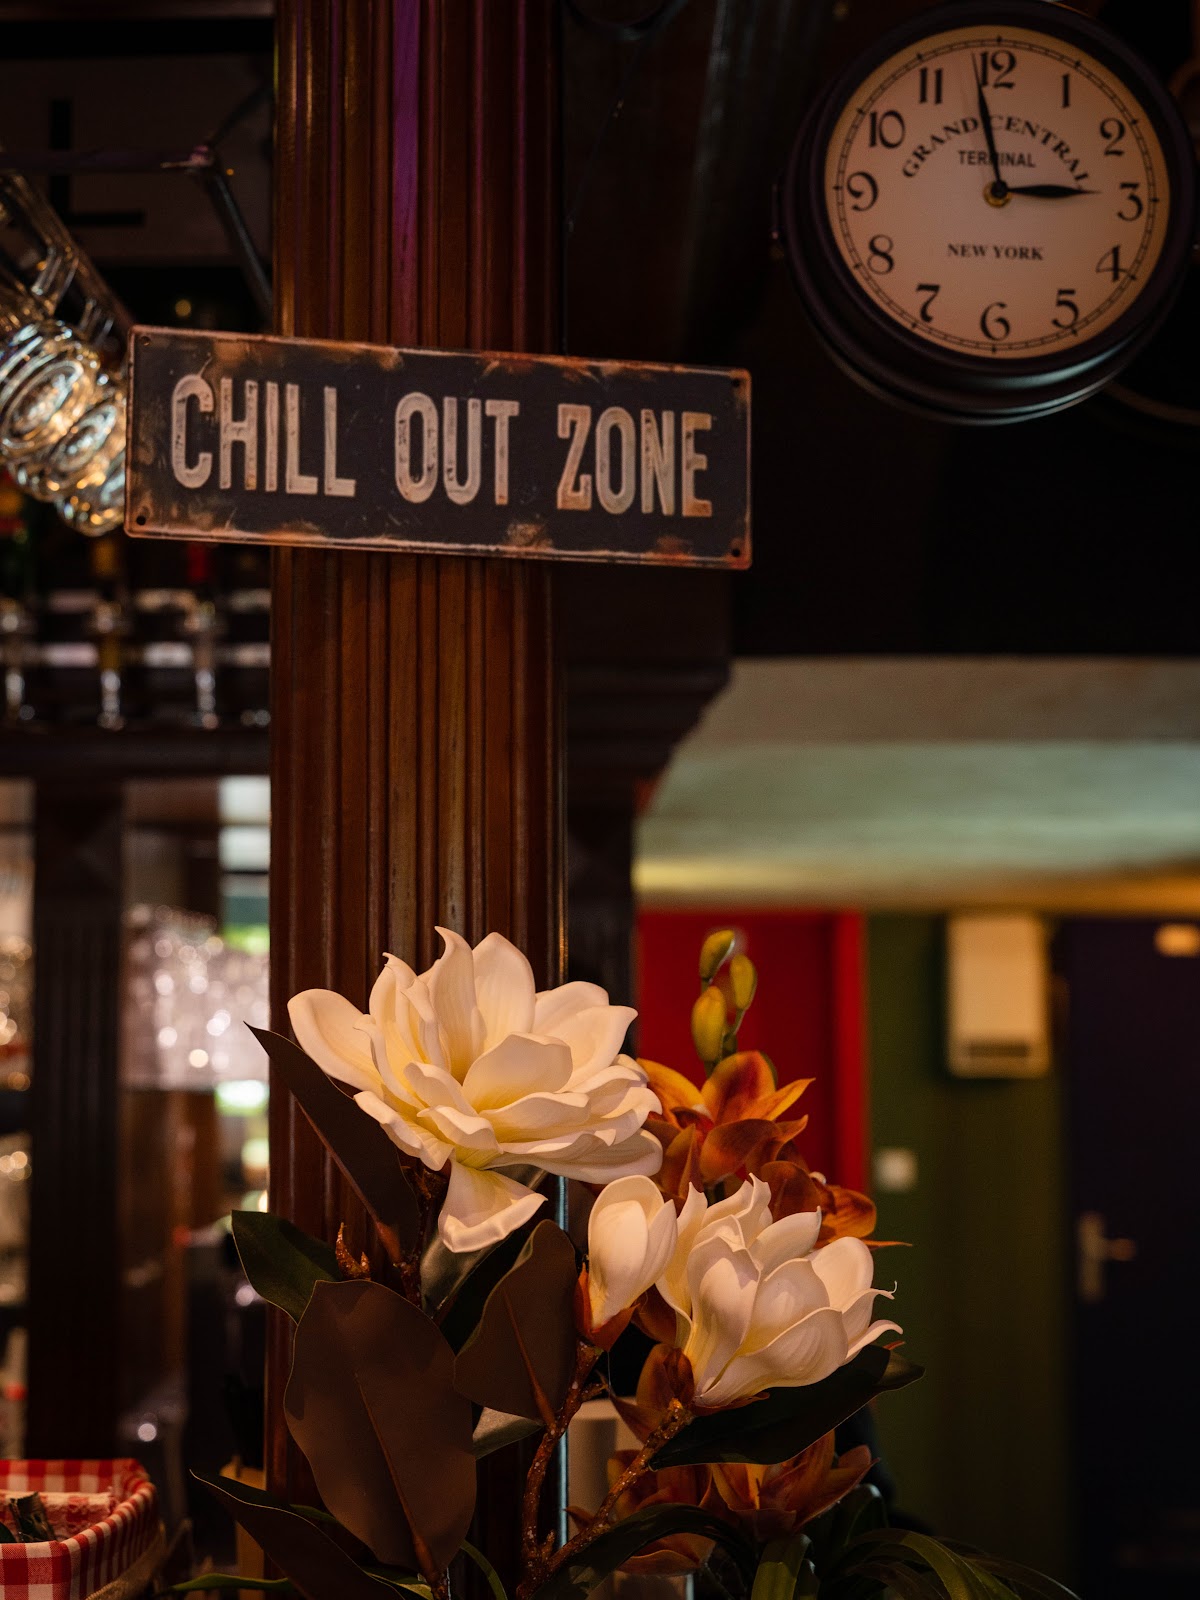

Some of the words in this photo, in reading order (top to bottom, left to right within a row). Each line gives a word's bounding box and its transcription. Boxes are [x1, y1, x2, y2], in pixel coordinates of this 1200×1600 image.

[919, 67, 943, 104] 11
[978, 50, 1016, 88] 12
[1061, 73, 1071, 108] 1
[868, 110, 905, 149] 10
[903, 116, 978, 178] GRAND
[1100, 118, 1125, 156] 2
[846, 171, 878, 212] 9
[1117, 182, 1143, 221] 3
[867, 235, 894, 275] 8
[947, 243, 986, 258] NEW
[993, 245, 1043, 261] YORK
[1095, 245, 1129, 282] 4
[916, 284, 940, 323] 7
[980, 302, 1010, 341] 6
[1051, 289, 1079, 329] 5
[170, 373, 357, 498] CHILL
[394, 391, 520, 506] OUT
[556, 403, 714, 519] ZONE
